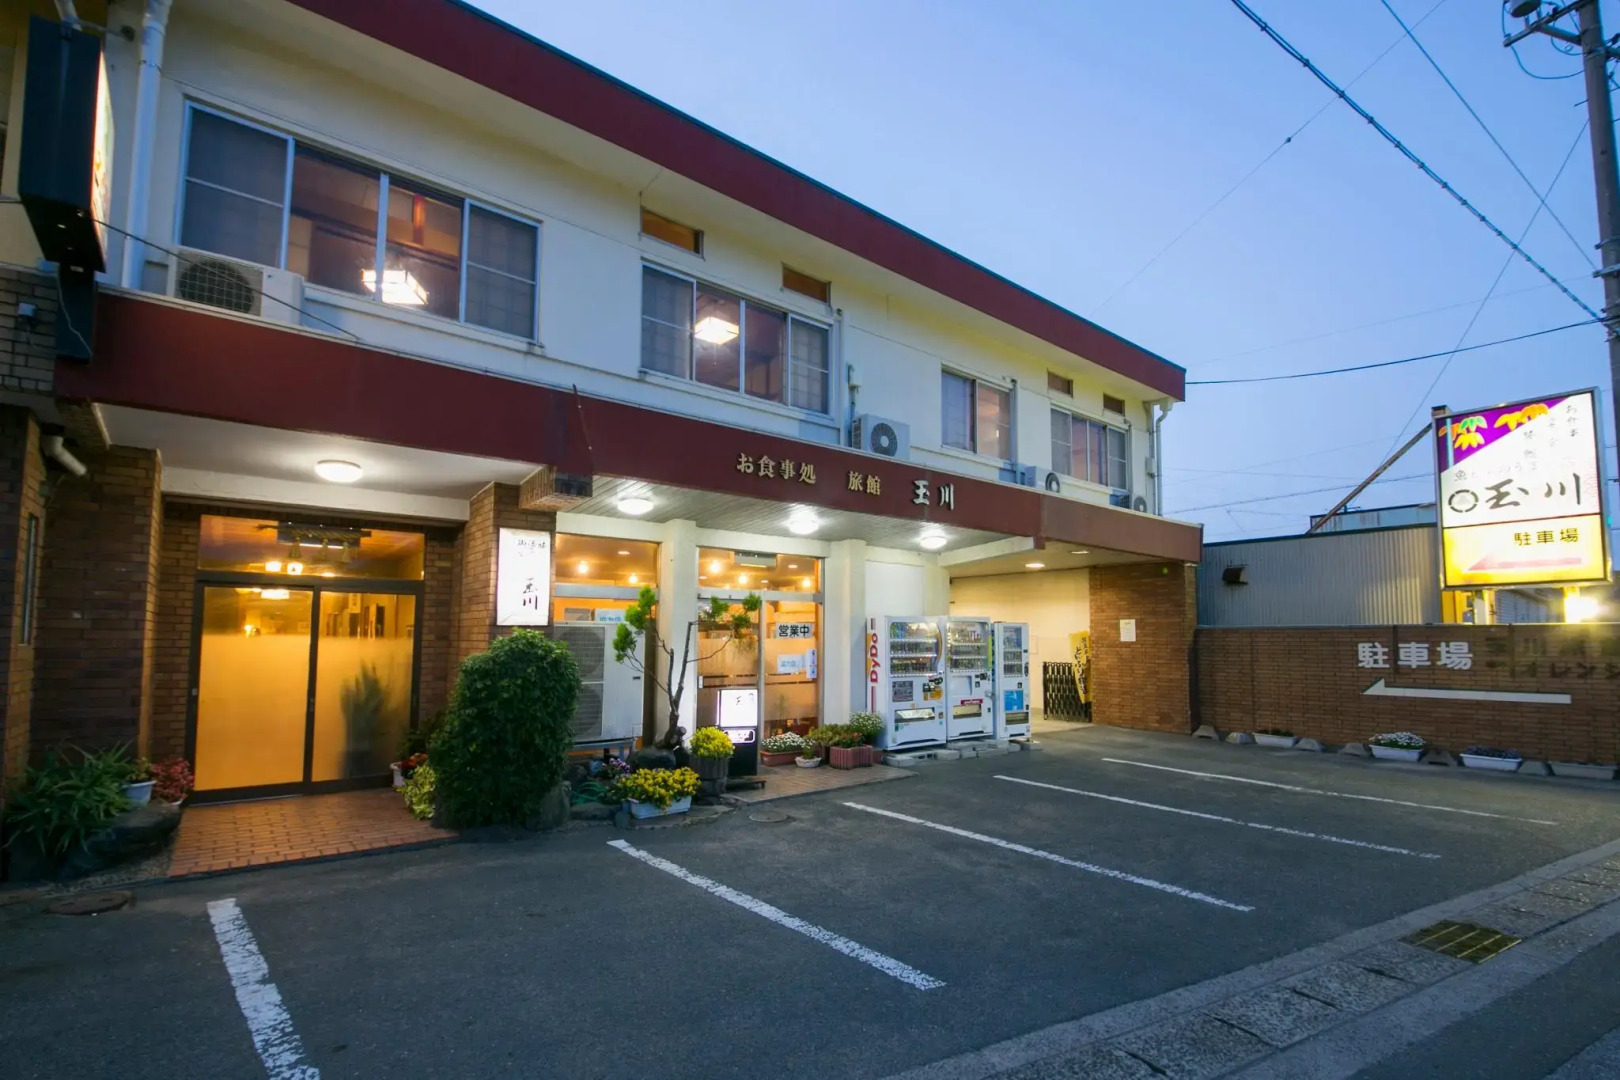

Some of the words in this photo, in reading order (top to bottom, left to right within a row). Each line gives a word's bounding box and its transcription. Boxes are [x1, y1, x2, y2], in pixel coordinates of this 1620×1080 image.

[736, 453, 817, 485] お食事処
[848, 471, 882, 496] 旅館
[912, 479, 956, 510] 玉川
[1484, 472, 1581, 510] 玉川
[1514, 528, 1580, 546] 駐車場
[778, 624, 811, 638] 営業中
[870, 633, 881, 683] DyDo
[1357, 642, 1473, 670] 駐車場
